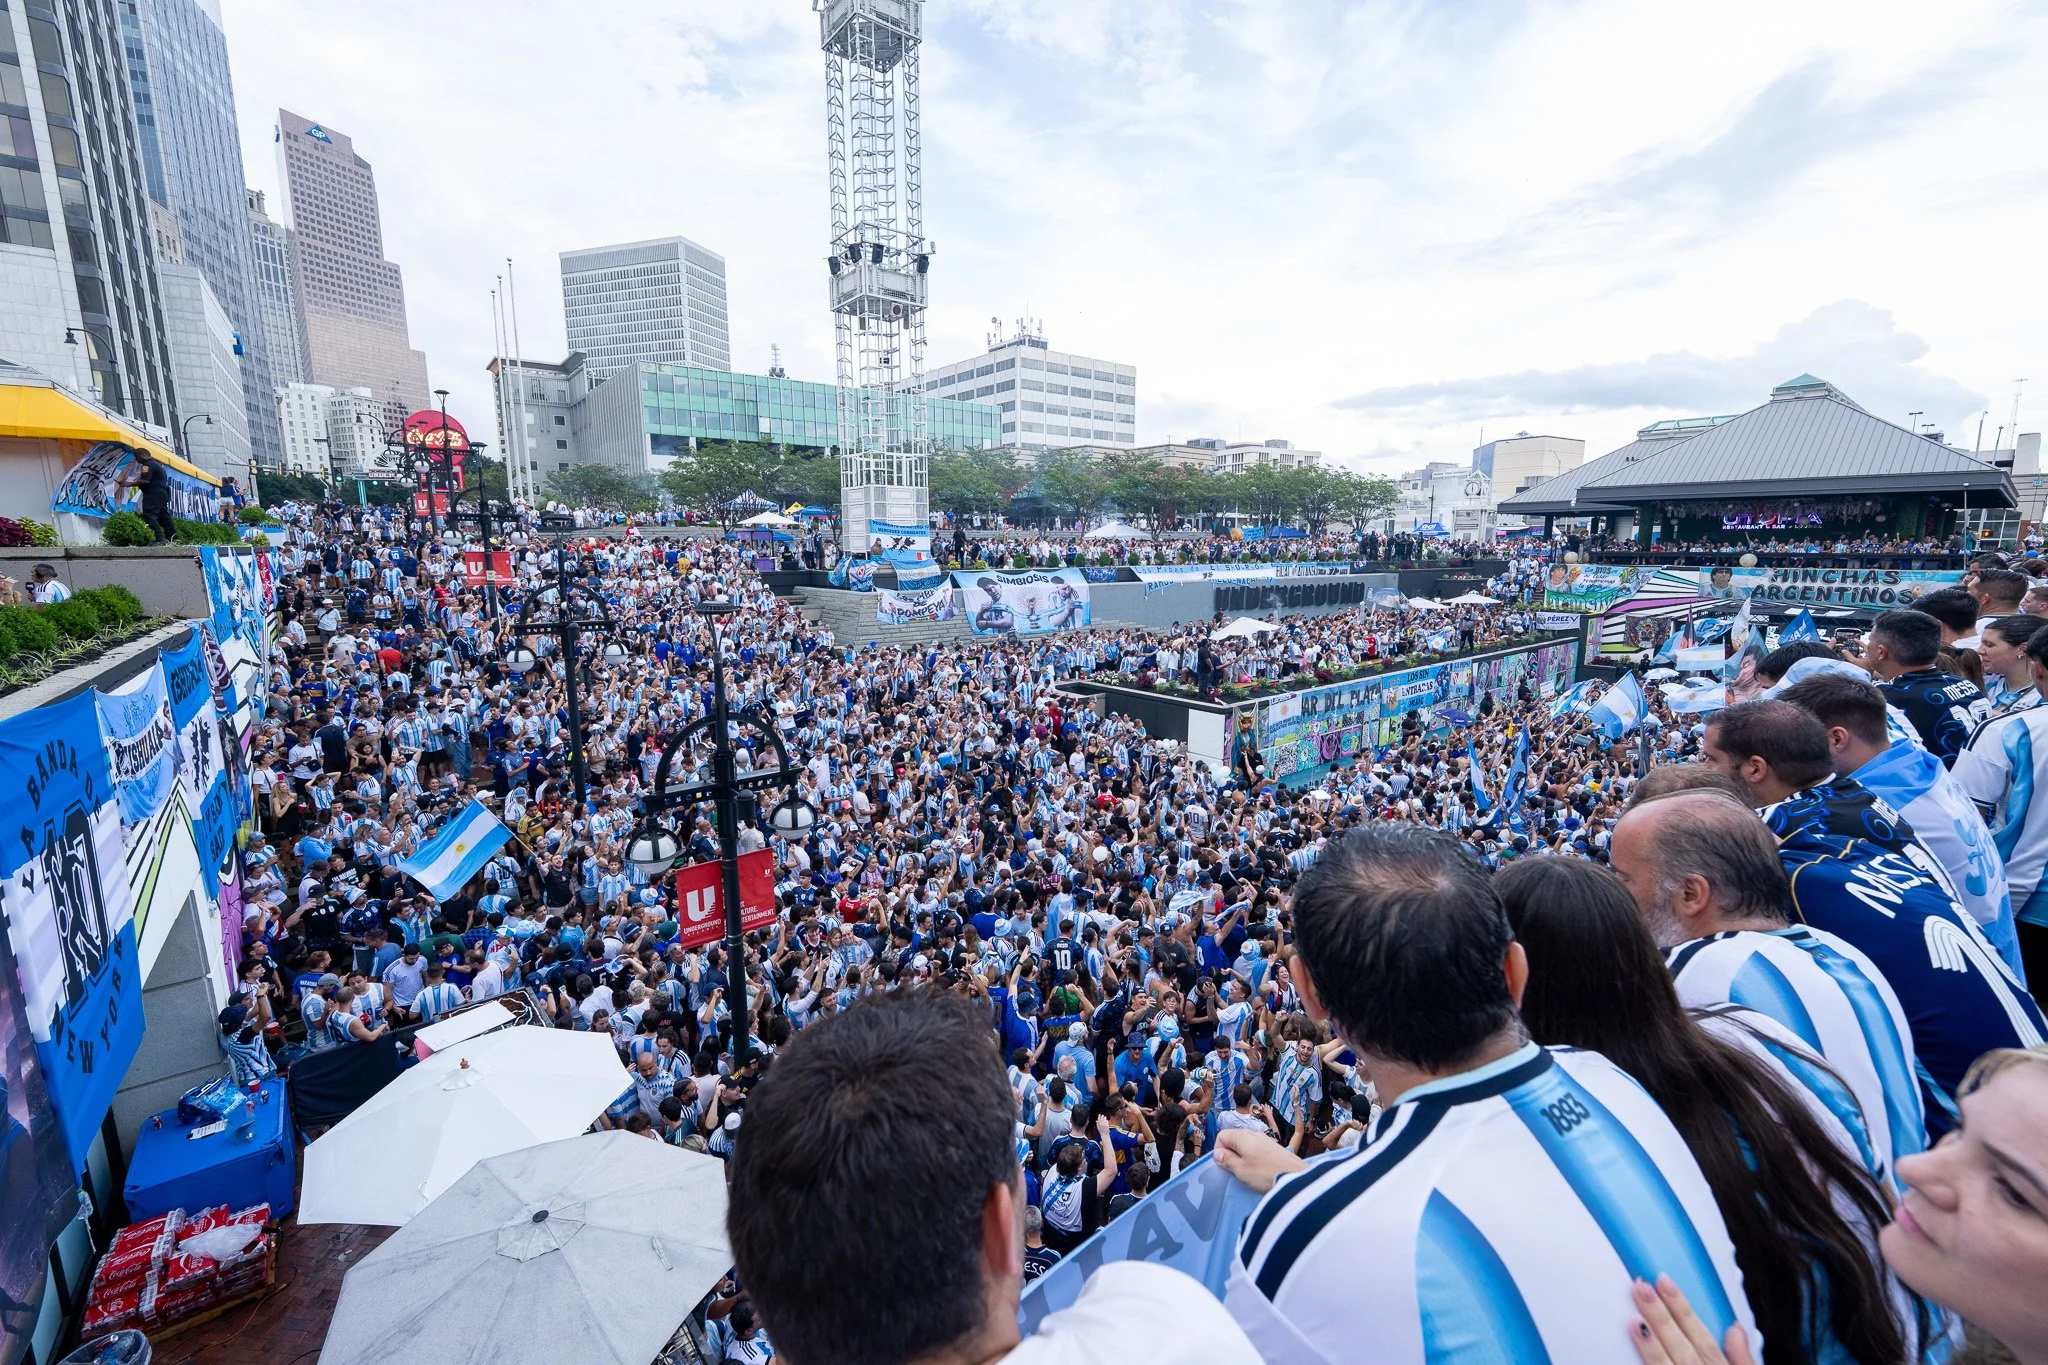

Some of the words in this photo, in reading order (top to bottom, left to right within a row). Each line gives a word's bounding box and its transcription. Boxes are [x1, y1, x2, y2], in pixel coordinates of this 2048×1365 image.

[311, 128, 326, 139] GP
[470, 562, 483, 575] U
[996, 573, 1050, 586] SIMBIOSIS
[1214, 582, 1366, 611] UNDERGROUND
[897, 599, 945, 618] POMPEYA
[1547, 613, 1569, 621] PÉREZ
[1407, 671, 1419, 682] LOS
[1419, 669, 1430, 680] SIN
[1324, 690, 1345, 714] DEL
[1845, 853, 1934, 919] MESS
[686, 886, 716, 922] U
[741, 908, 775, 924] TERTAINMENT.
[683, 918, 722, 935] UNDERGROUND
[1054, 950, 1071, 970] 10
[51, 1001, 94, 1073] NEW
[101, 929, 122, 1053] YORK
[1539, 1091, 1591, 1137] 1893
[109, 1262, 142, 1280] Coca-Cola
[103, 1279, 137, 1299] Coca-Cola
